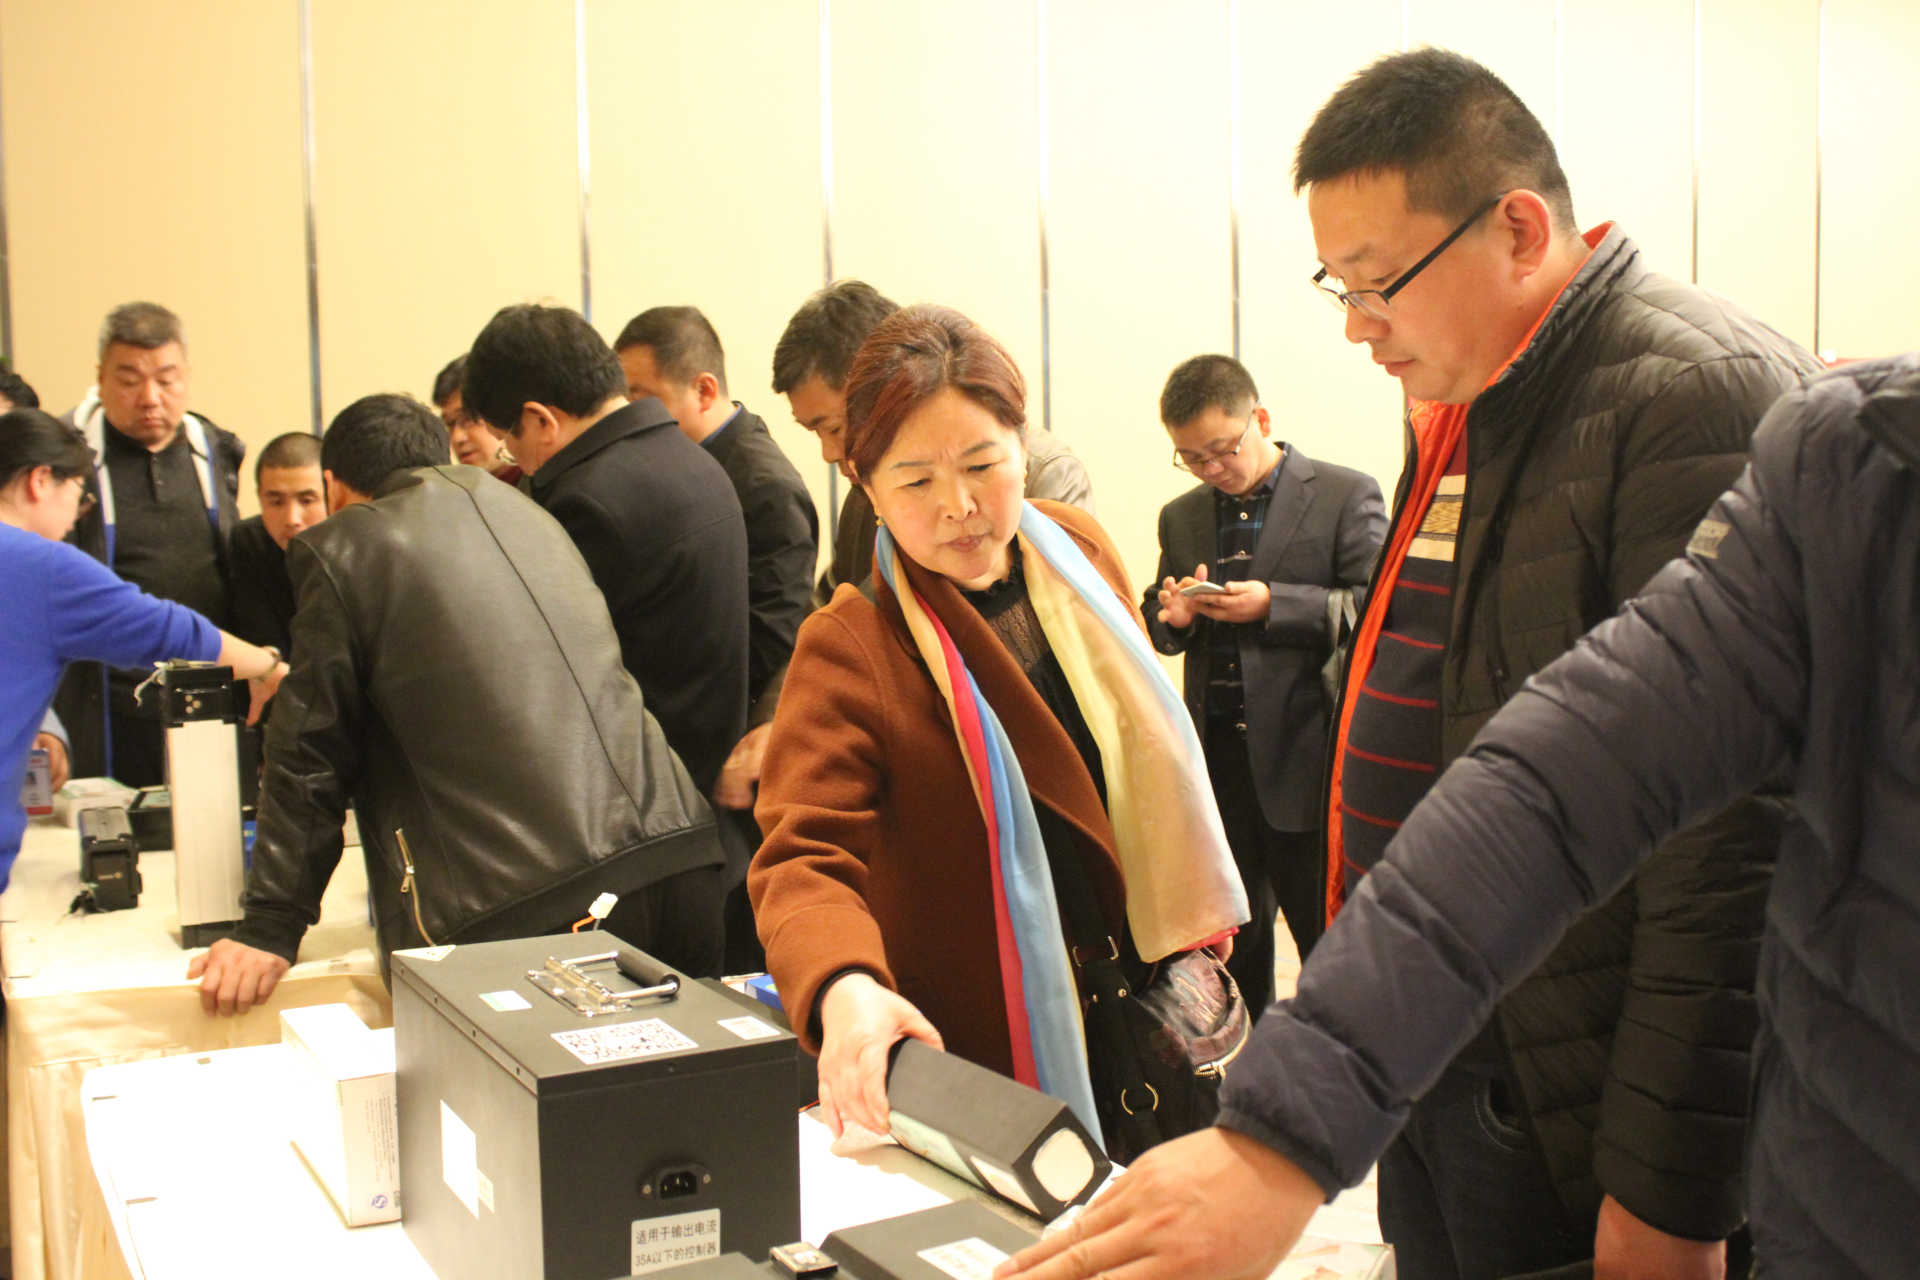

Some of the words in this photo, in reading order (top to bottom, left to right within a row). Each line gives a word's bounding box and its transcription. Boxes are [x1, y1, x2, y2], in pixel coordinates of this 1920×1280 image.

[635, 1219, 717, 1245] 适用于输出电流
